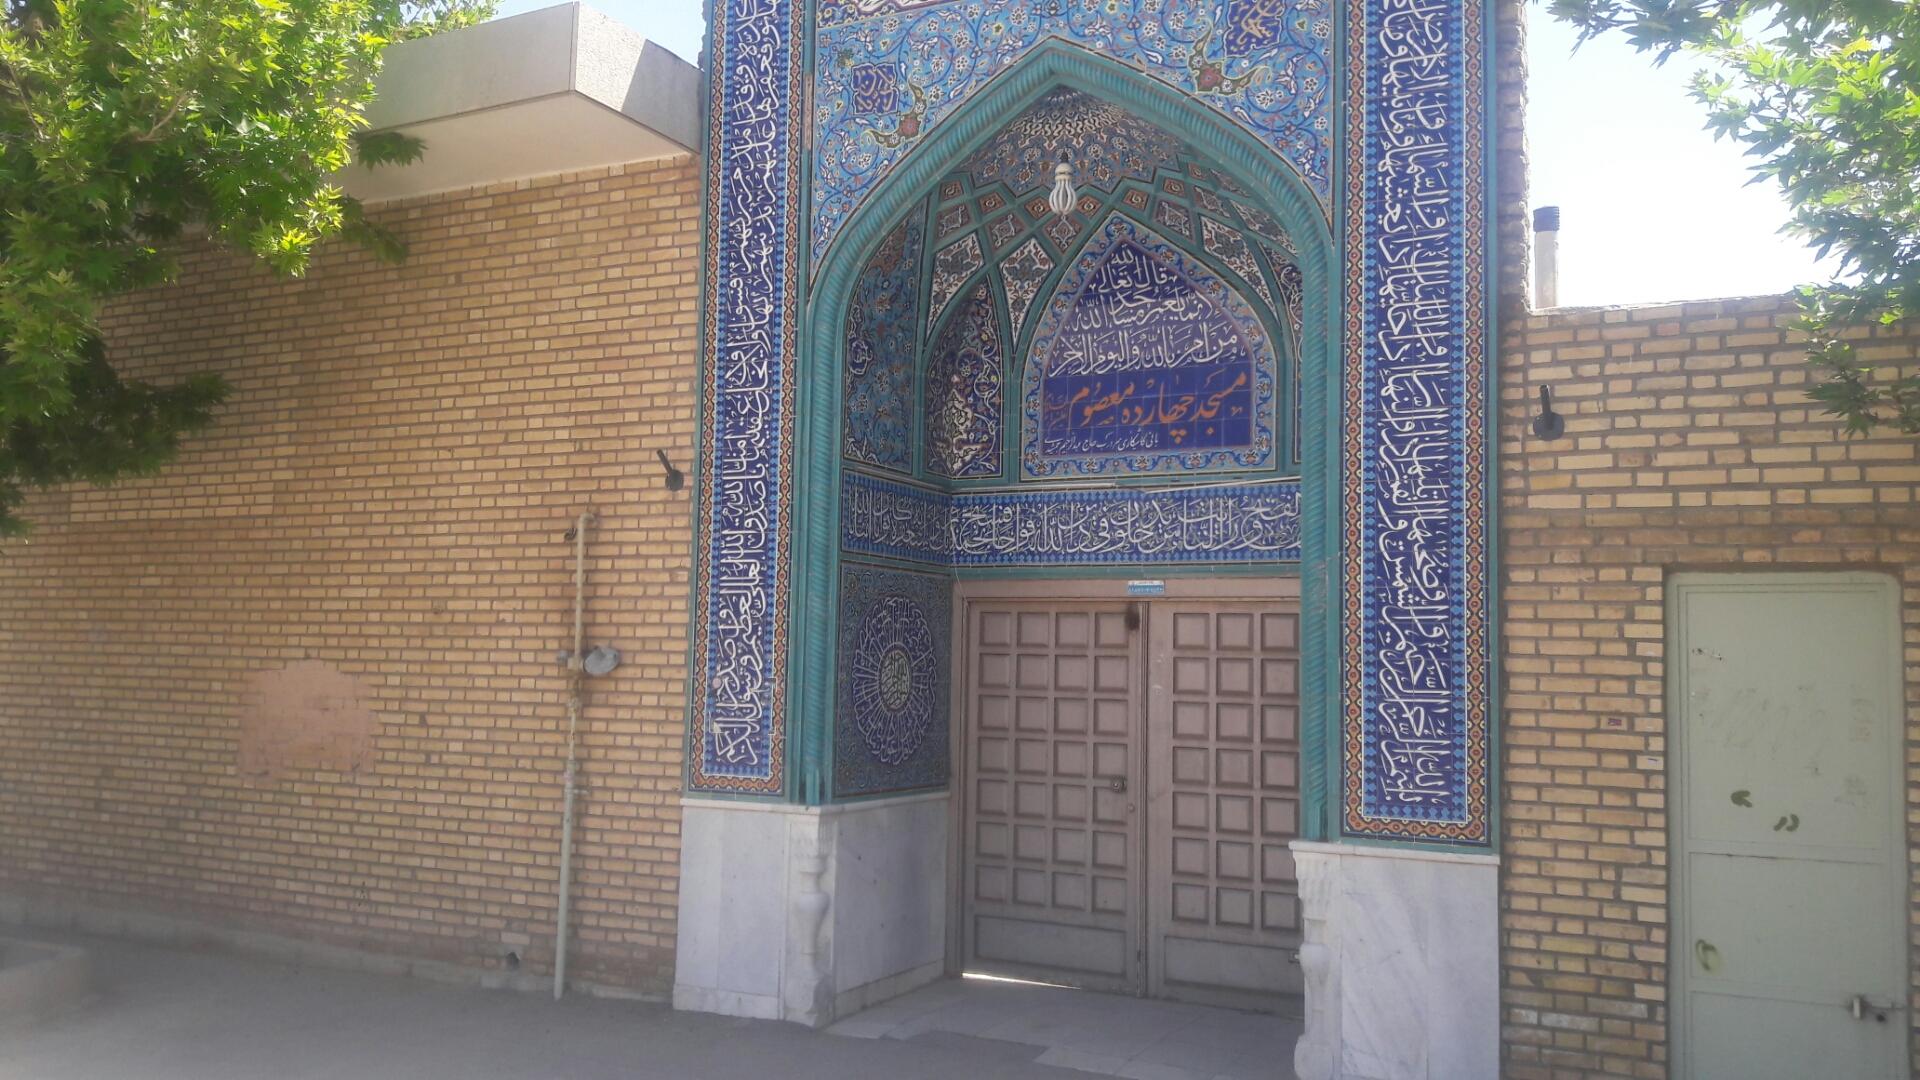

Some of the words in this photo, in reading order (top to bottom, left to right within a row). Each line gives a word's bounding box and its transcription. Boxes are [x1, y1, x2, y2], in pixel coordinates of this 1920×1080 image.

[1135, 255, 1168, 287] قال
[1069, 382, 1136, 430] معصوم
[1120, 382, 1196, 444] چهارده
[1190, 371, 1247, 435] مسجد
